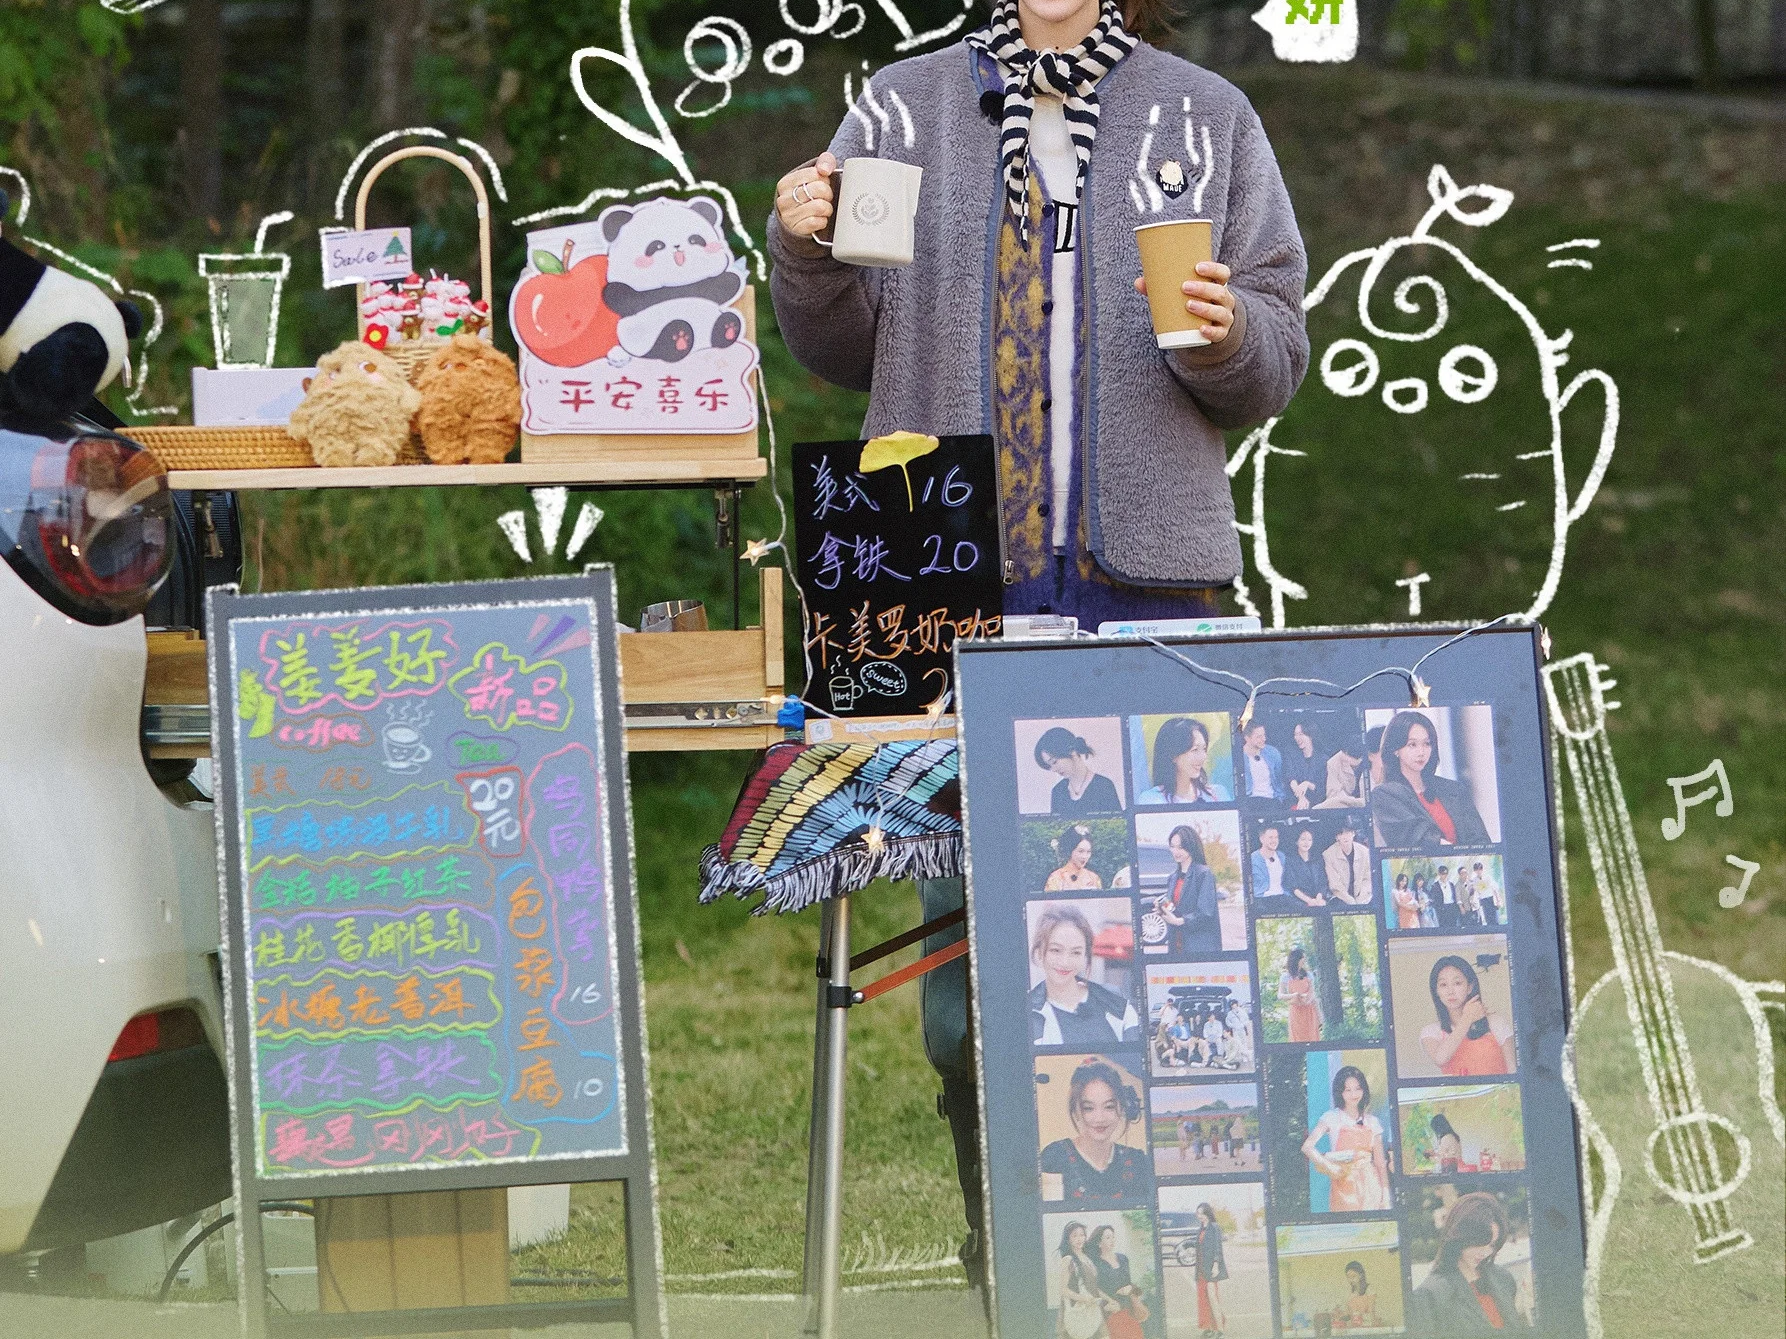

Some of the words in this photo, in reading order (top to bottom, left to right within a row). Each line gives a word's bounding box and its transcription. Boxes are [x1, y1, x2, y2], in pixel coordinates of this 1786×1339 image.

[559, 376, 729, 414] 平安喜乐
[810, 455, 881, 520] 美式
[922, 465, 973, 507] 16
[807, 530, 912, 590] 拿铁
[918, 534, 980, 576] 20
[275, 625, 447, 705] 姜姜好
[464, 653, 560, 724] 新品
[834, 692, 851, 702] Hot
[257, 975, 476, 1029] 冰糖老普洱
[508, 876, 563, 1108] 包浆豆腐
[569, 983, 601, 1004] 16
[574, 1077, 604, 1100] 10
